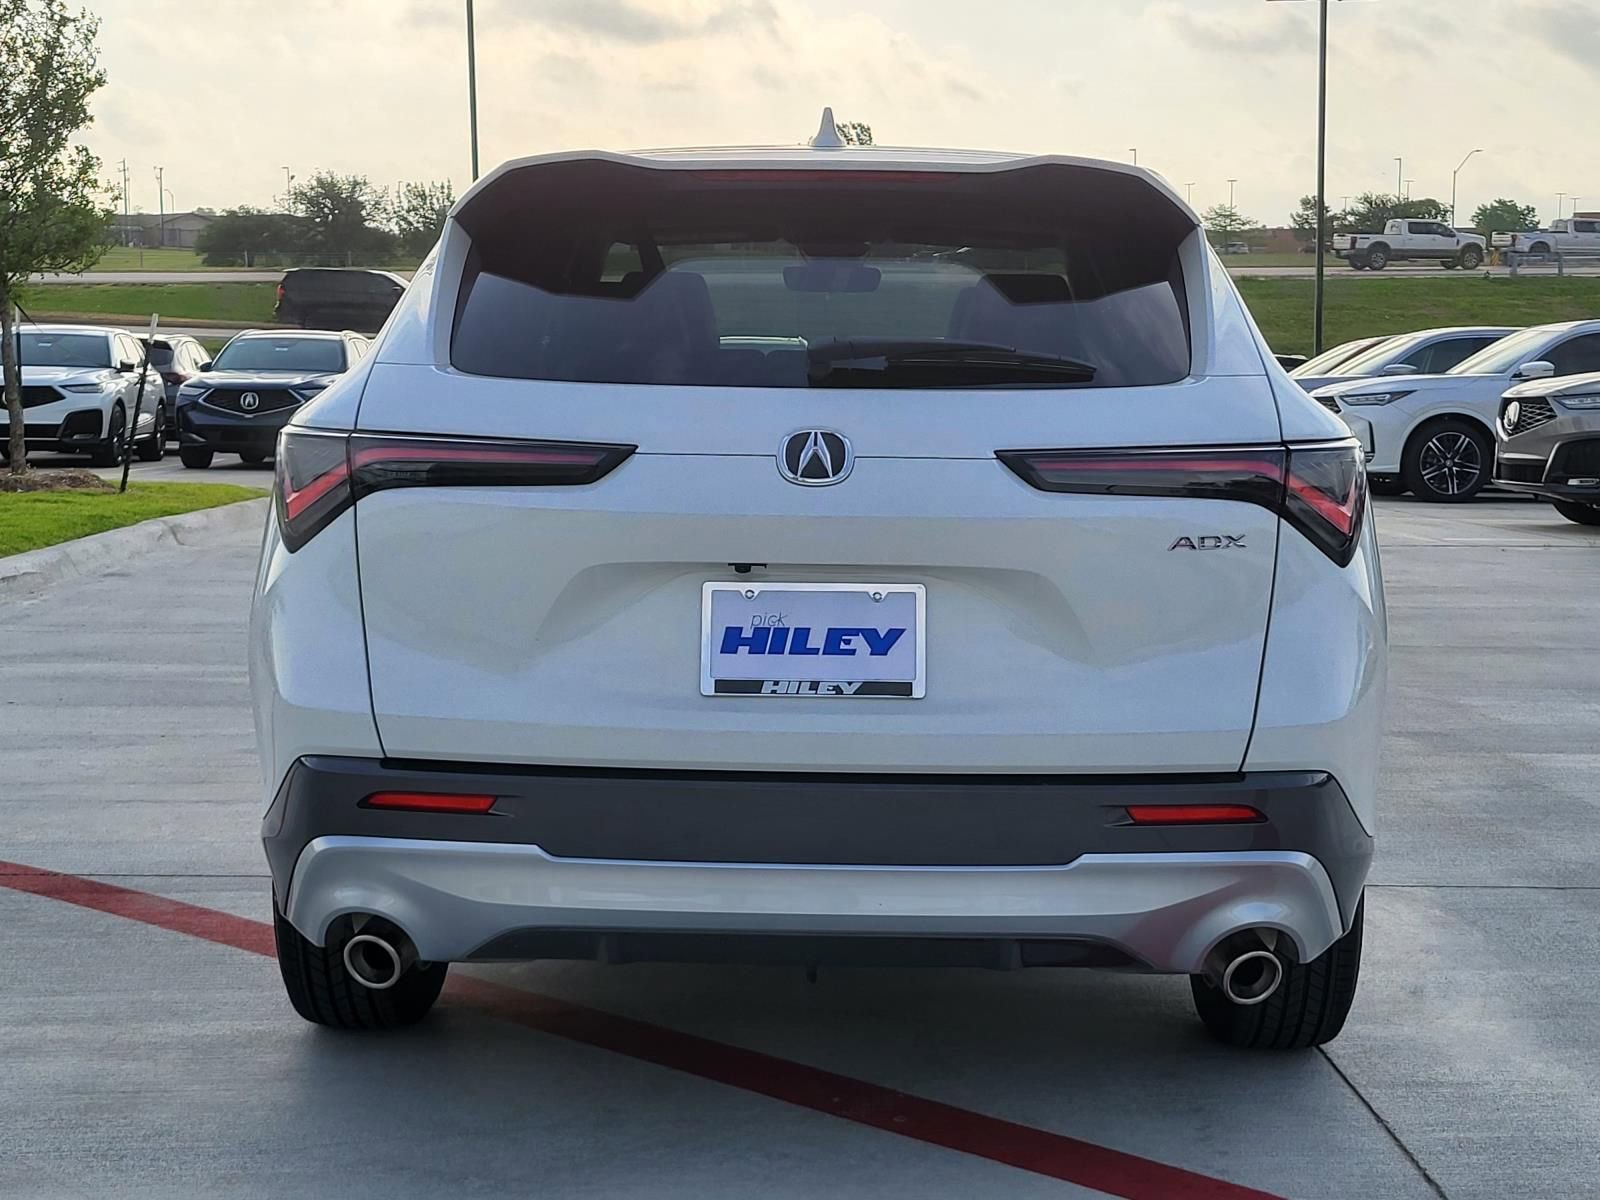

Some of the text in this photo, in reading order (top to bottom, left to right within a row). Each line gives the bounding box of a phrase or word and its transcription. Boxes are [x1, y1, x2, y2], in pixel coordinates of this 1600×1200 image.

[1168, 534, 1248, 551] ADX
[750, 612, 787, 629] pick
[720, 626, 907, 656] HILEY
[760, 681, 863, 694] HILEY
